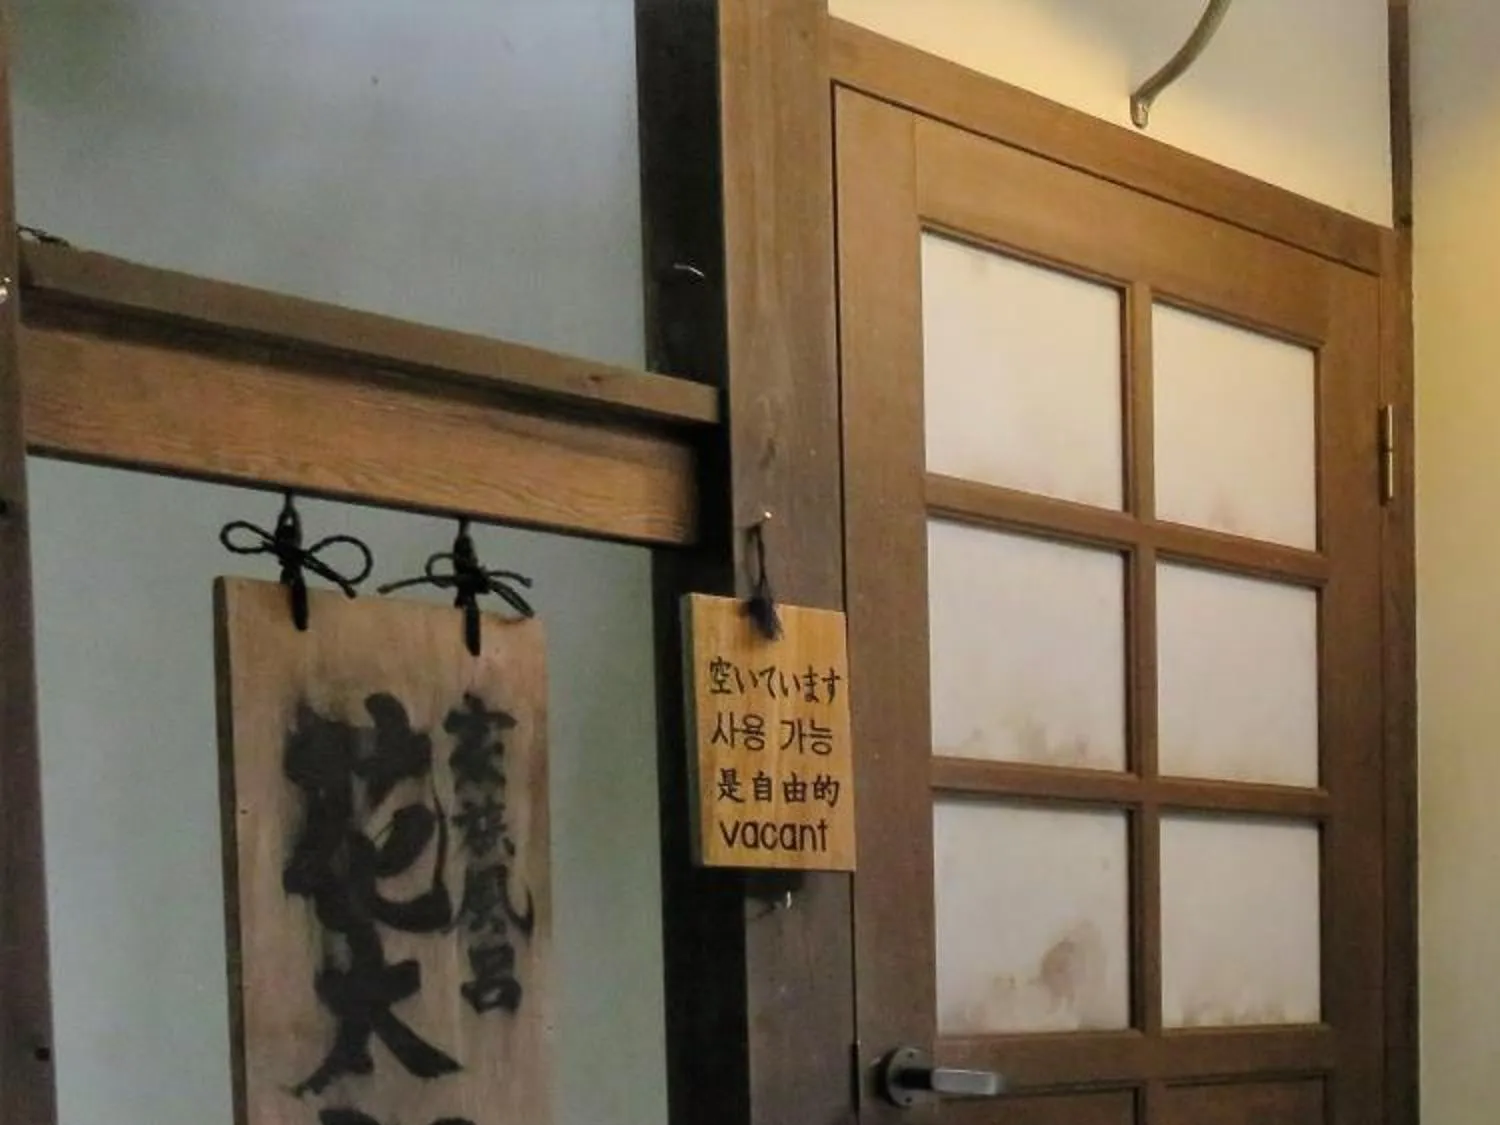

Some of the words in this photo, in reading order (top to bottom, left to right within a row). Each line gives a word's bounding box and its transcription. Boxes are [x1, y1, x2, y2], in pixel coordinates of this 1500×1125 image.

[709, 656, 841, 704] 空いています
[711, 711, 766, 751] 사용
[780, 716, 834, 756] 가능
[717, 768, 840, 808] 是自由的
[443, 692, 535, 1015] 家族風呂
[719, 818, 829, 852] vacant
